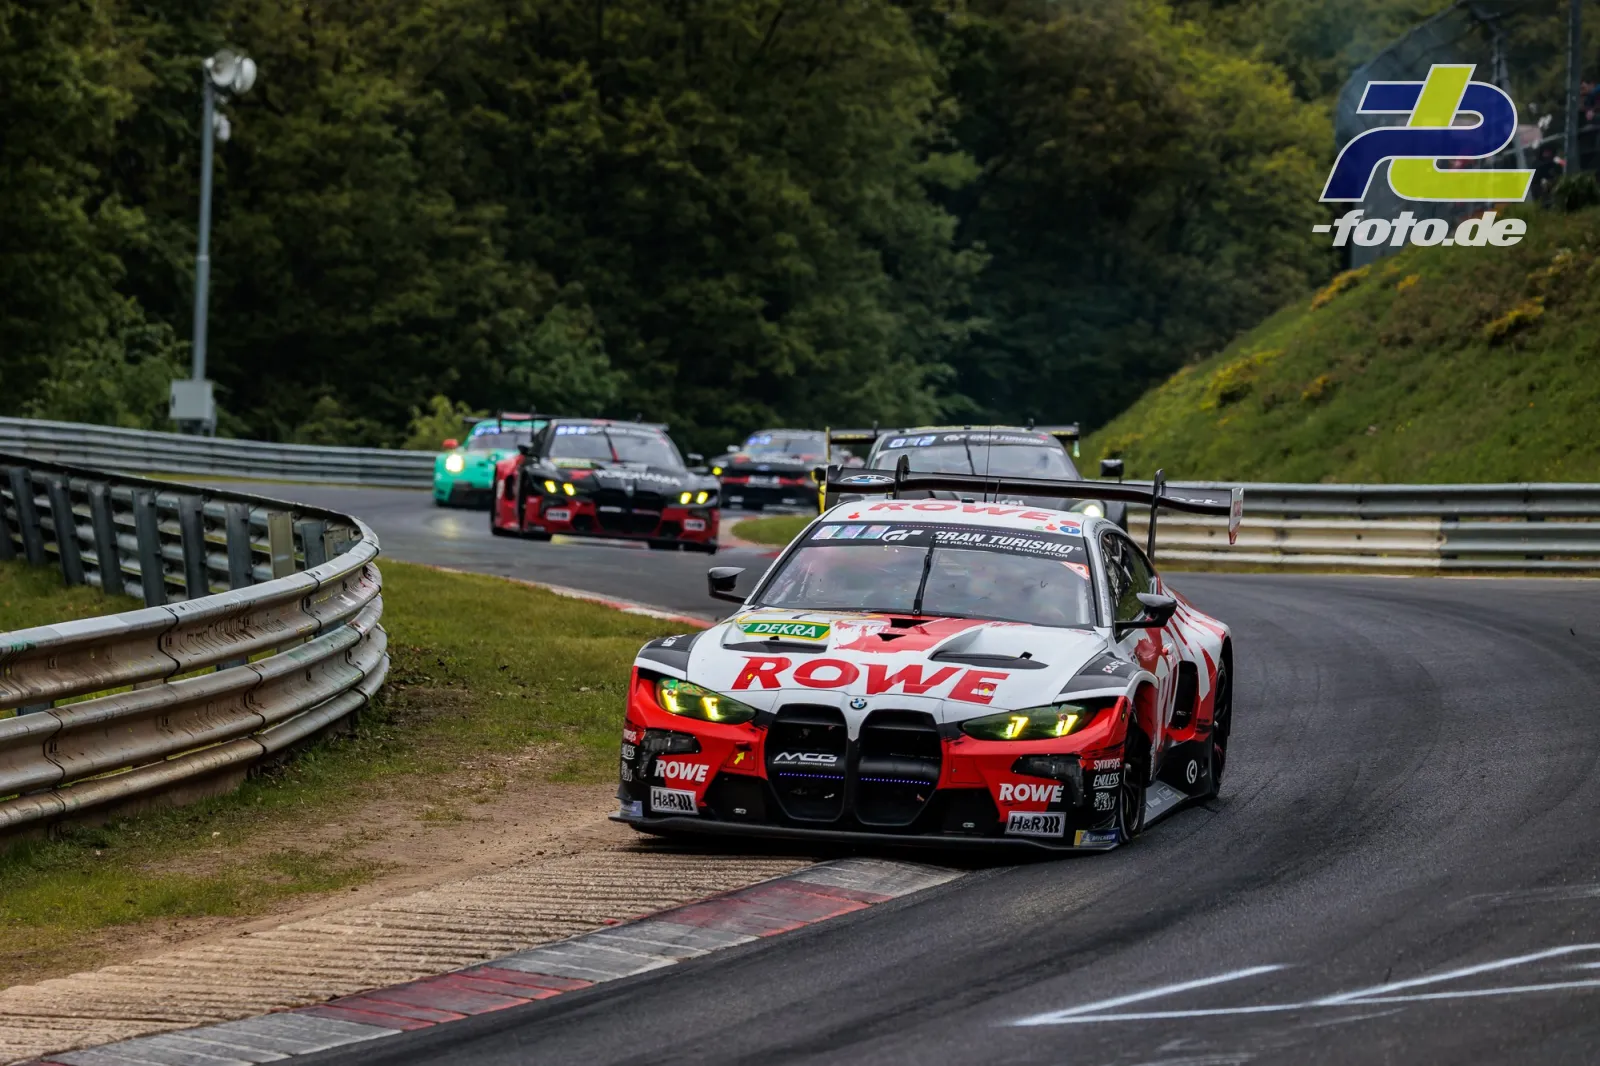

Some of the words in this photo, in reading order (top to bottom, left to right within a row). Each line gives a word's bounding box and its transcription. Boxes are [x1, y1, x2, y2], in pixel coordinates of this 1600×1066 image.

[868, 502, 1057, 521] ROWE
[934, 531, 984, 543] GRAN
[975, 542, 1013, 551] DRIVING
[1015, 547, 1069, 559] SIMULATOR
[753, 623, 816, 637] DEKRA
[731, 656, 1010, 705] ROWE
[774, 751, 838, 763] MCG
[1093, 757, 1121, 772] SYNOPSYS
[654, 760, 709, 783] ROWE
[1093, 773, 1119, 788] ENDLESS
[653, 790, 677, 808] H&R
[999, 783, 1064, 803] ROWE
[1010, 815, 1041, 832] H&R
